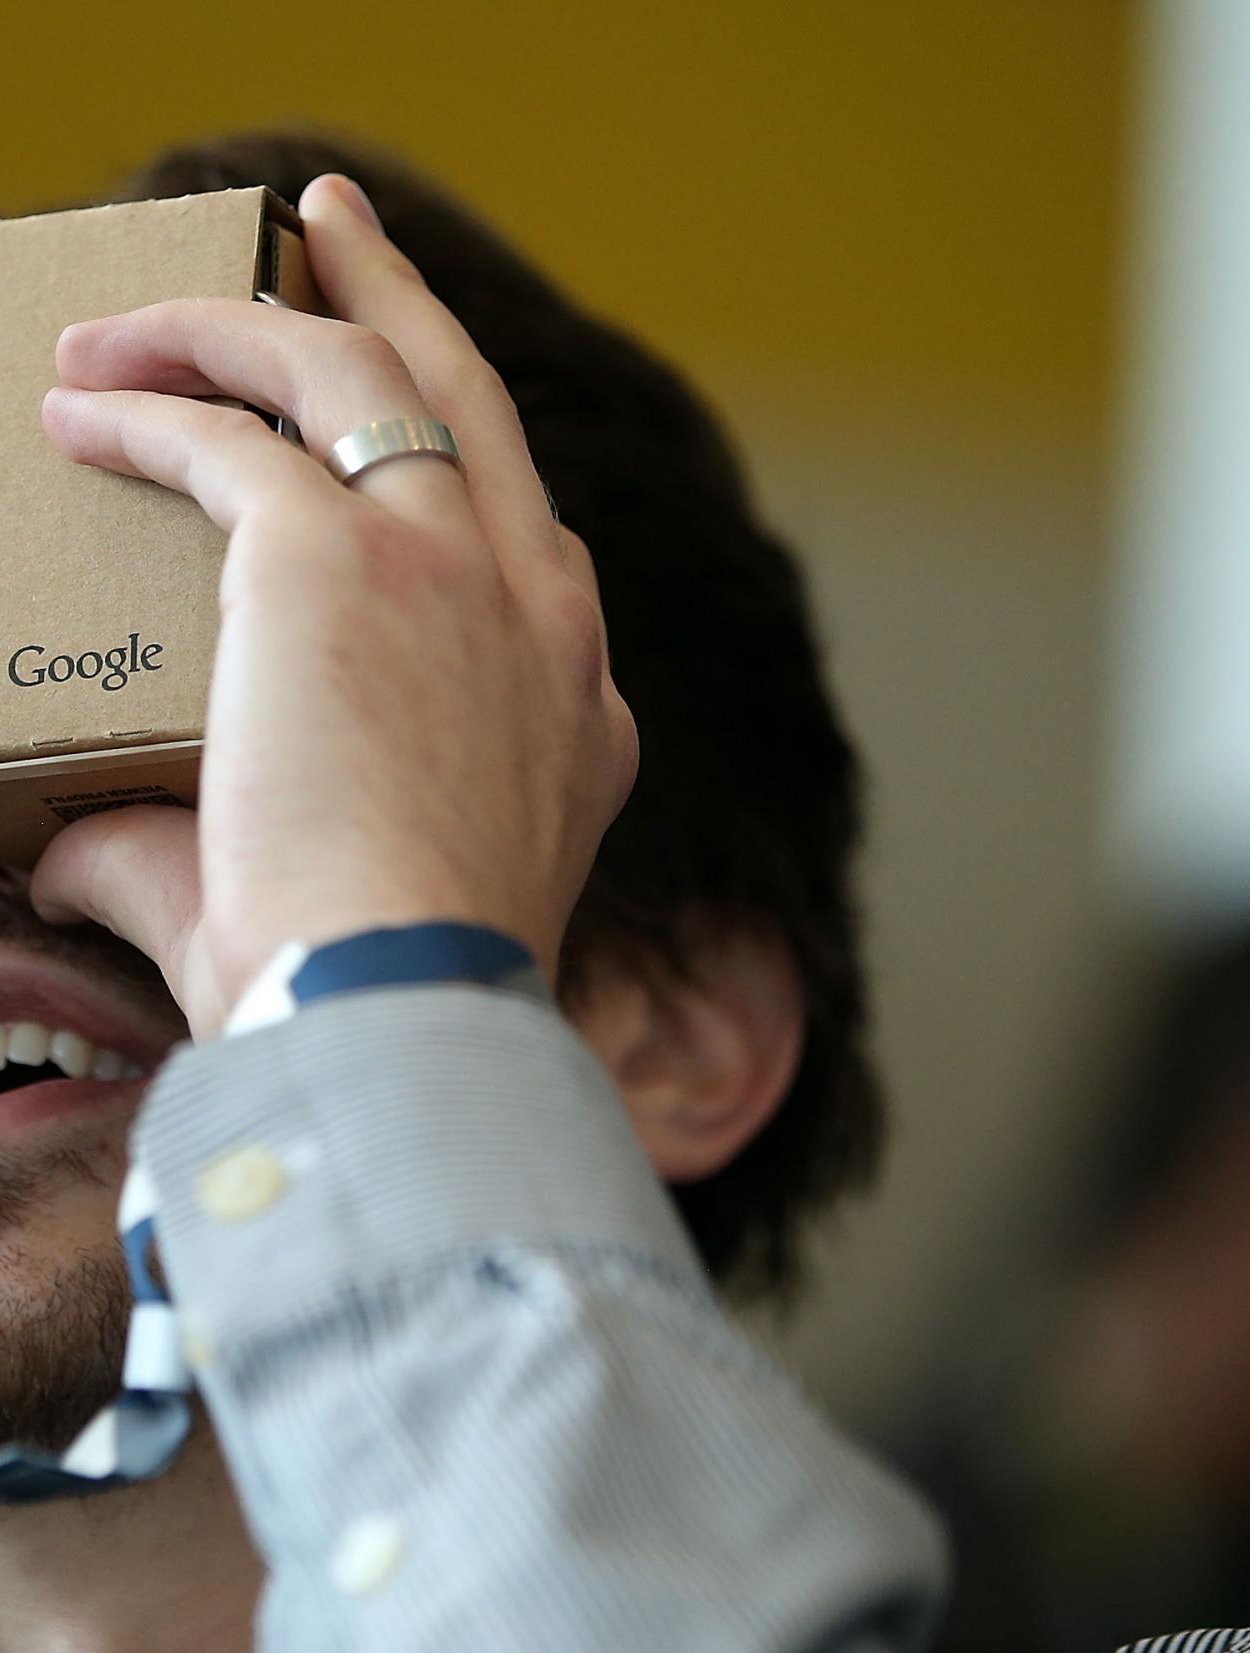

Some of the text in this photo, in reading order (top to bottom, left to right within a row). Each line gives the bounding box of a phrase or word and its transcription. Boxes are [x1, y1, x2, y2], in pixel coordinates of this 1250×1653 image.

[8, 633, 164, 691] Google
[40, 784, 167, 805] VIEWER PROFILE
